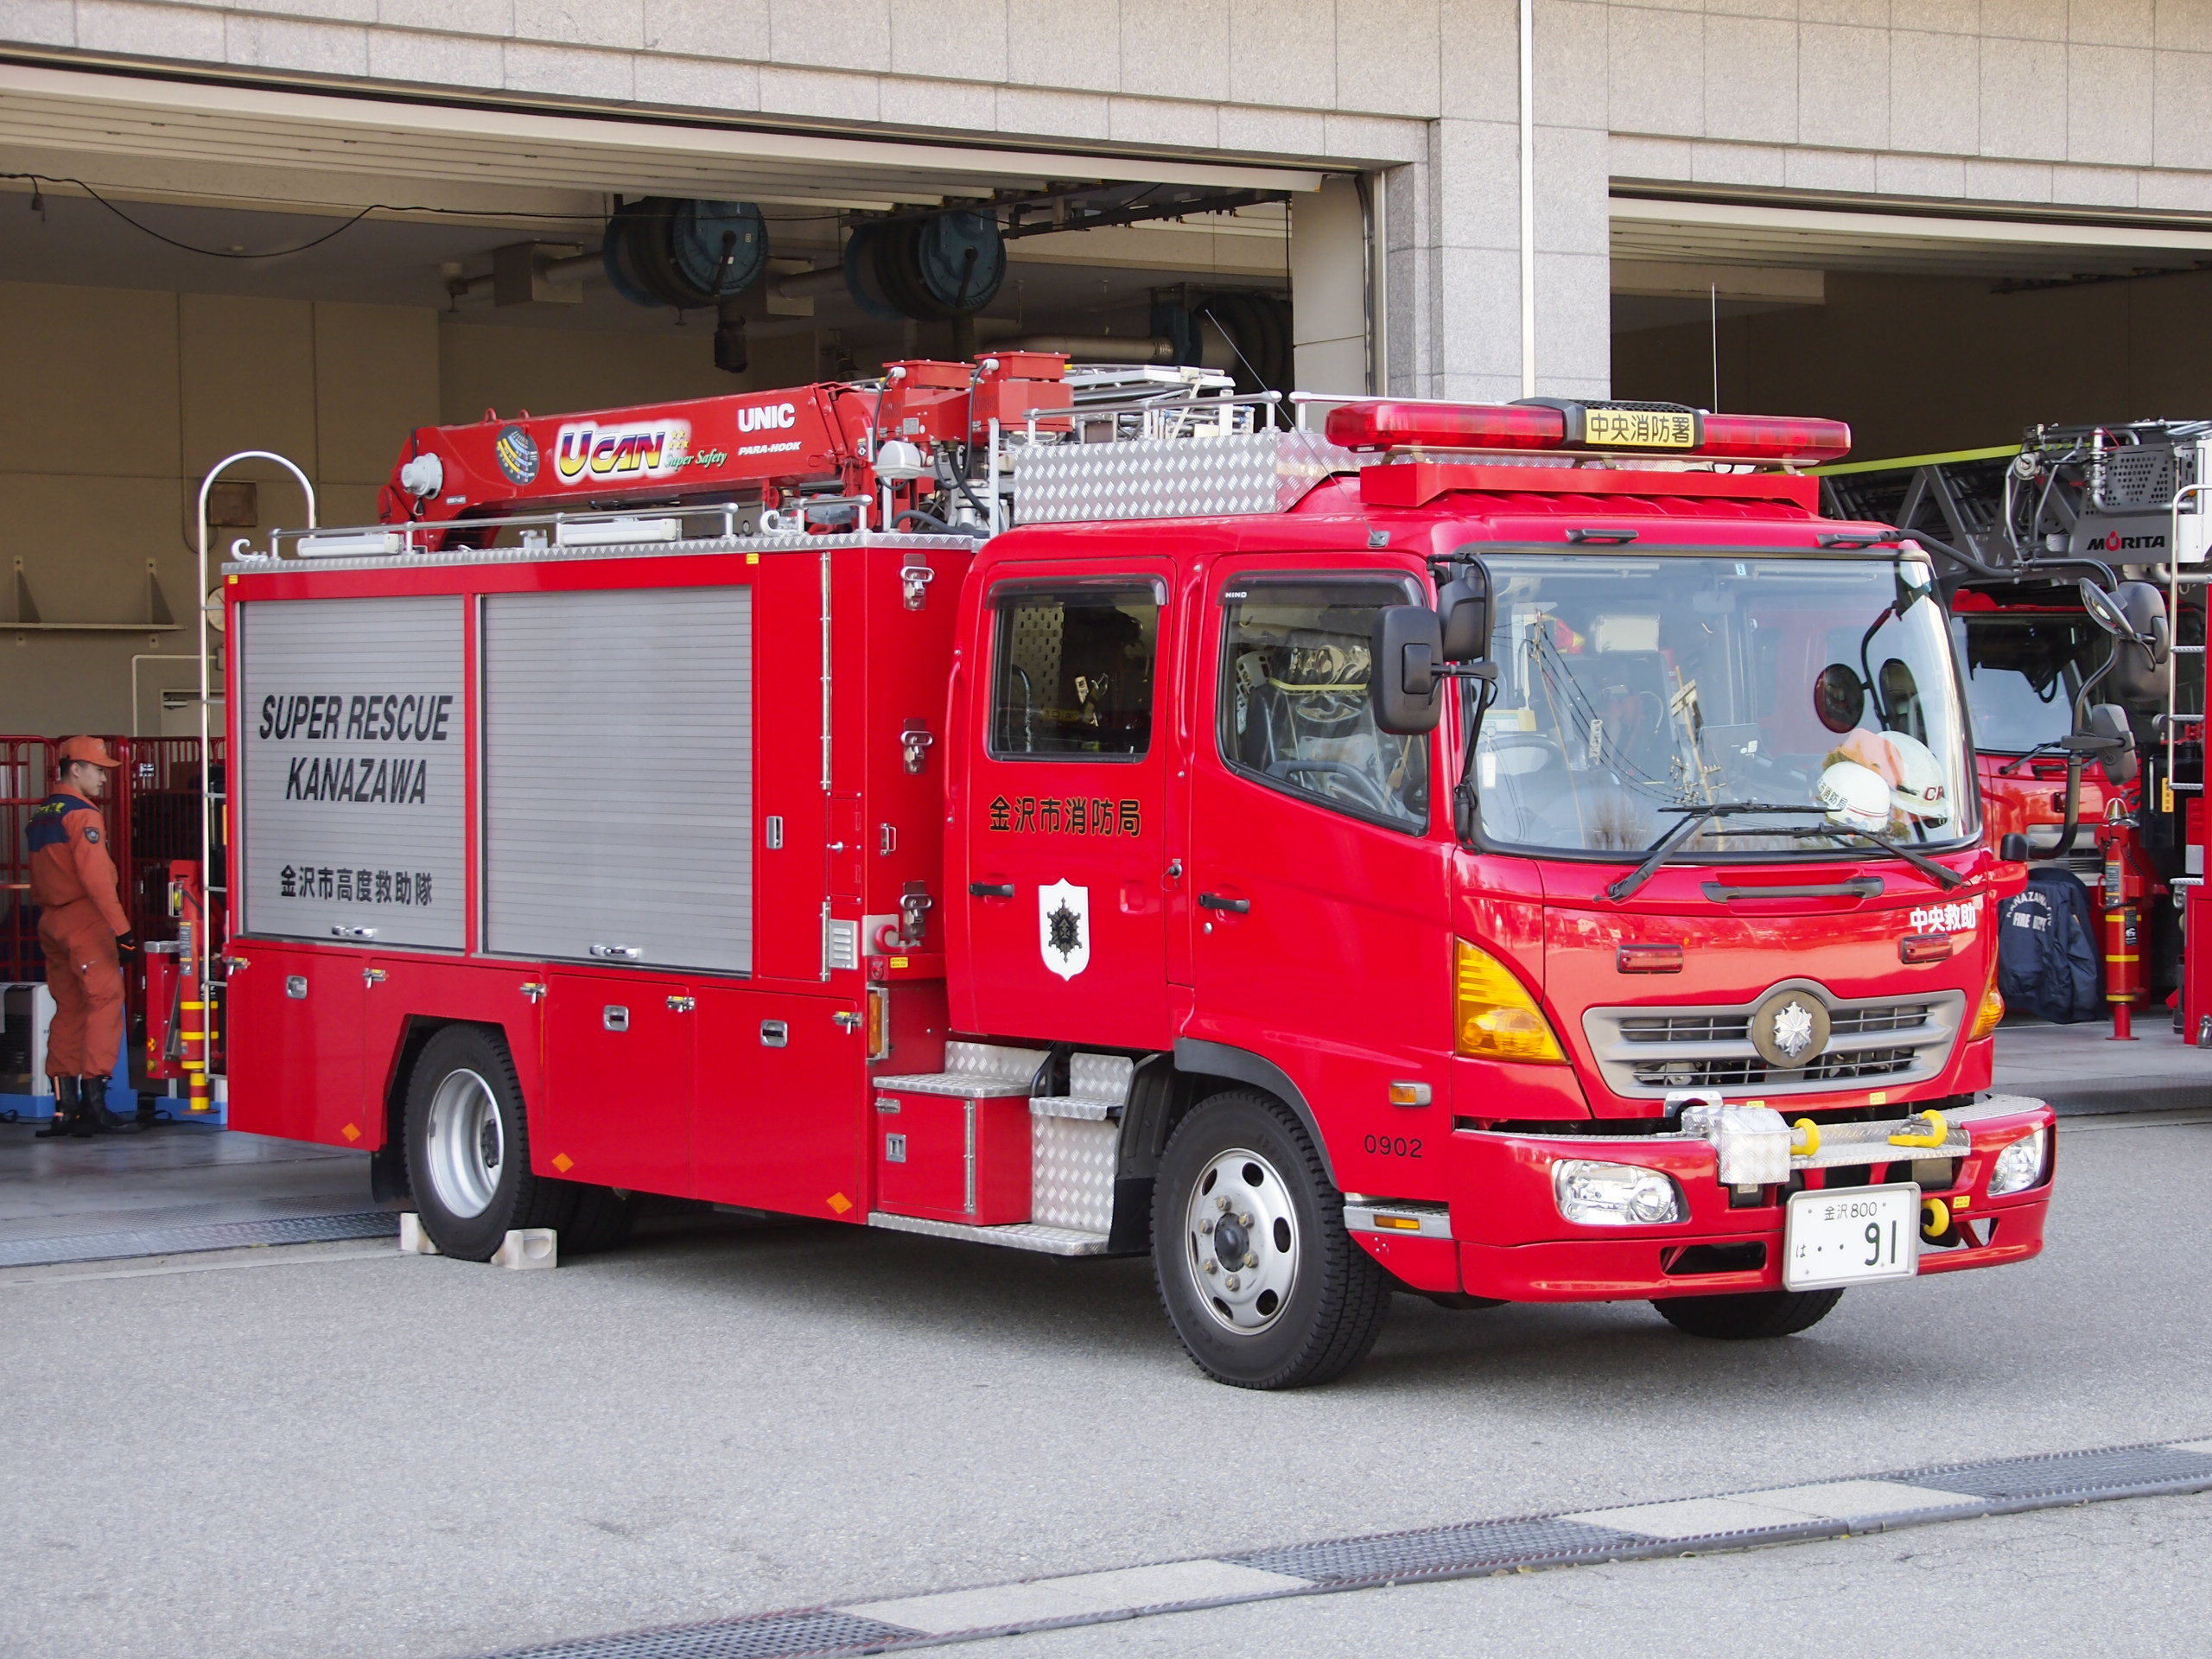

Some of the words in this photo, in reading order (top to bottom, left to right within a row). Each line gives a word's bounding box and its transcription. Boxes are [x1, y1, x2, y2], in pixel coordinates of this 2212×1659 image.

[738, 403, 796, 433] UNIC
[1591, 413, 1690, 443] 中央消防署
[664, 453, 695, 472] Super
[695, 448, 728, 469] Safety
[738, 442, 803, 456] PARA-HOOK
[2087, 531, 2165, 551] MORITA
[258, 695, 343, 741] SUPER
[346, 694, 454, 741] RESCUE
[286, 757, 428, 804] KANAZAWA
[988, 794, 1141, 836] 金沢市消防局
[280, 865, 433, 906] 金沢市高度救助隊
[1910, 902, 1976, 933] 中央救助
[1364, 1135, 1423, 1158] 0902
